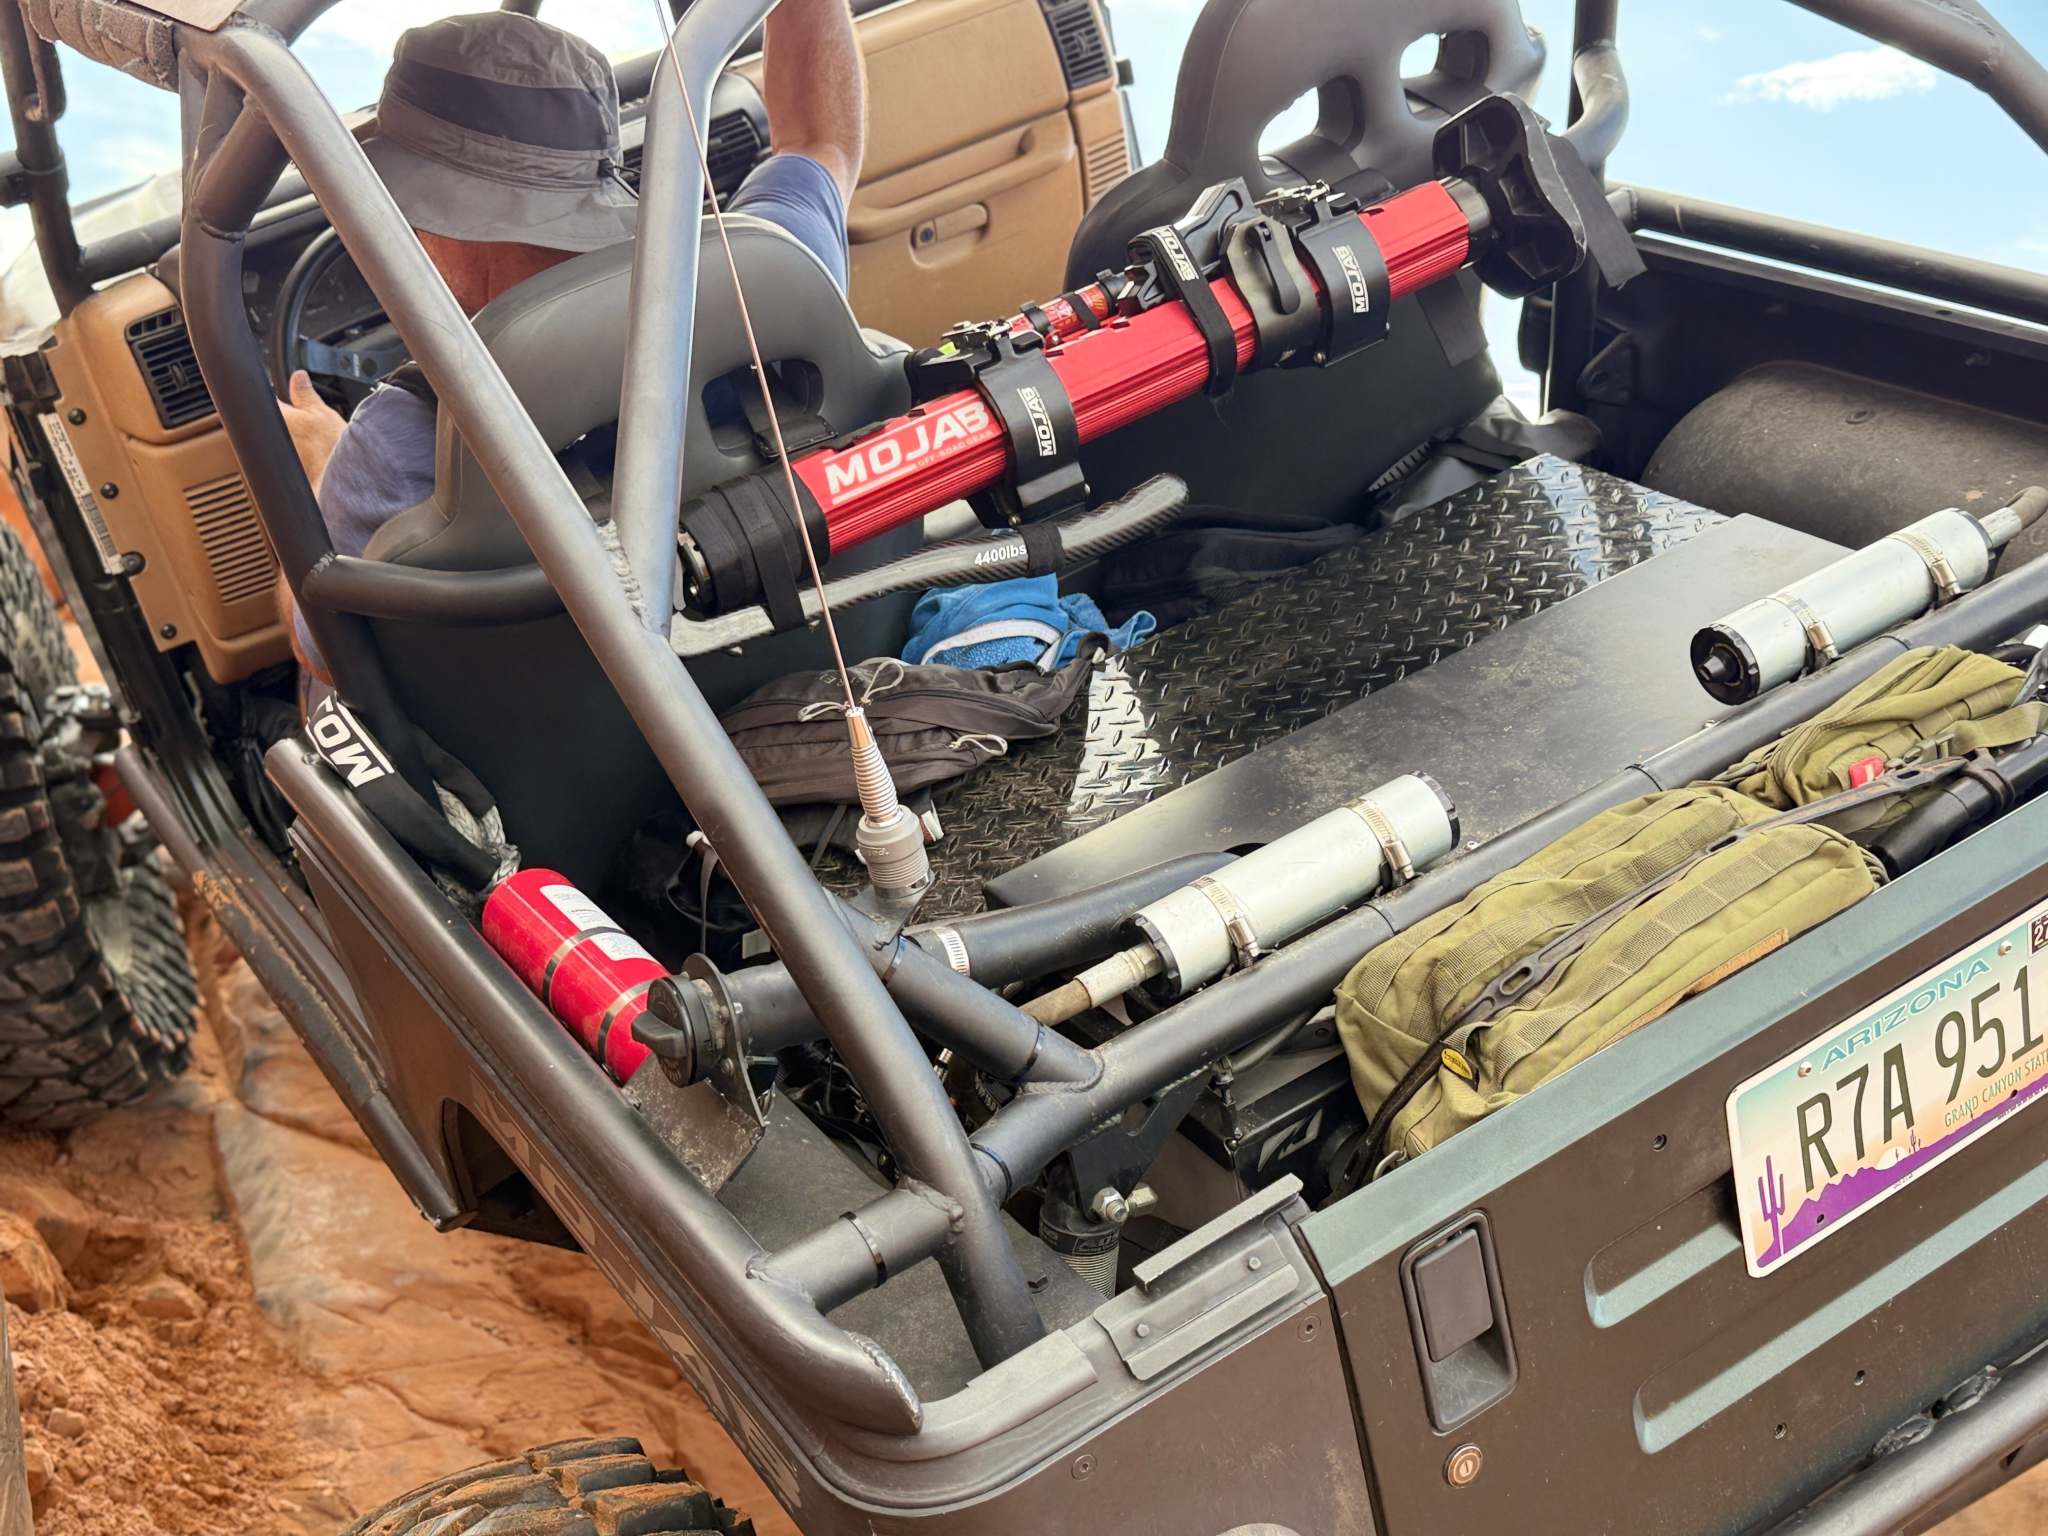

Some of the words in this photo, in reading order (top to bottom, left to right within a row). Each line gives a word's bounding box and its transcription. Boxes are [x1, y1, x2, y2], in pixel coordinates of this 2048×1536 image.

[1335, 246, 1366, 312] MOJAB
[825, 401, 989, 494] MOJAB
[1020, 387, 1054, 456] MOJAB
[974, 545, 1027, 565] 4400lbs
[1821, 958, 1992, 1073] ARIZONA
[1796, 1043, 1915, 1193] R7A
[1935, 964, 2044, 1105] 951
[1945, 1095, 1979, 1128] GRAND
[1982, 1066, 2022, 1103] CANYON
